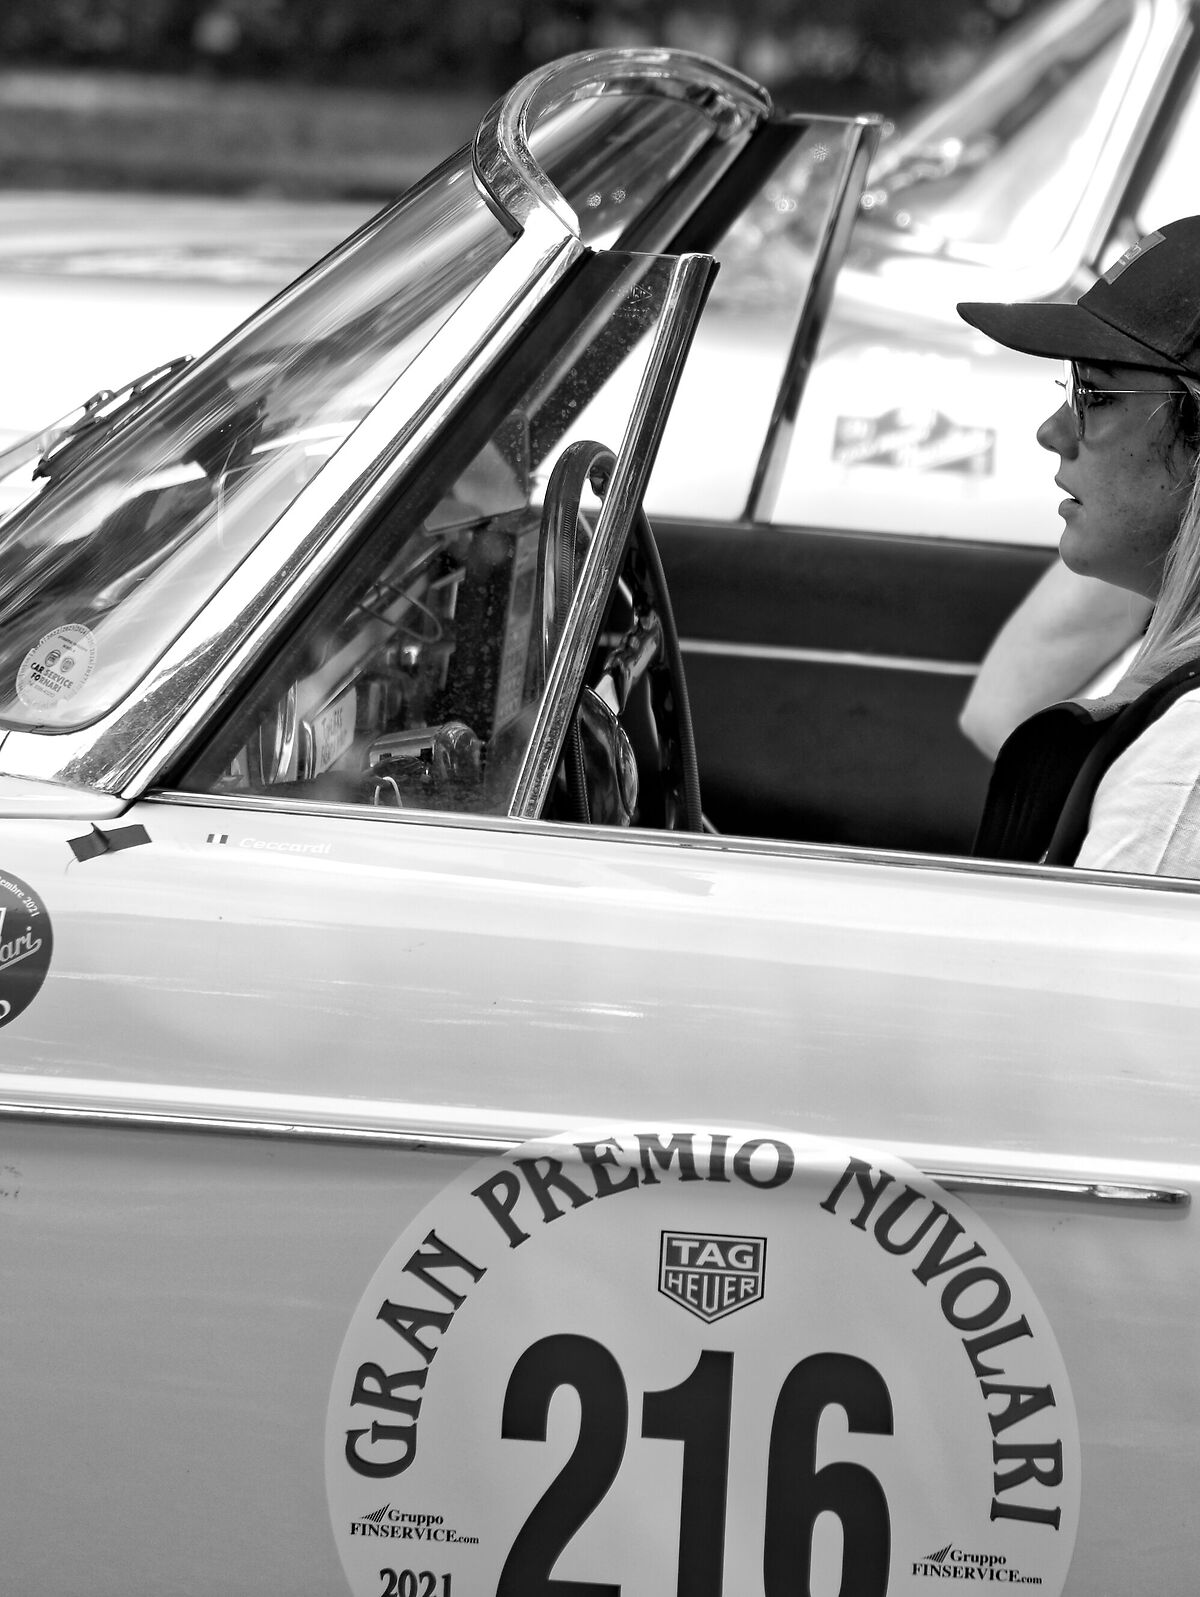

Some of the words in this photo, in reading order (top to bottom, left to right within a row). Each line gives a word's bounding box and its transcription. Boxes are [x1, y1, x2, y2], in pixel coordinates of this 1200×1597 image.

[30, 662, 45, 674] CAR
[44, 669, 74, 689] SERVICE
[30, 672, 62, 693] FORNARI
[22, 896, 40, 917] 2021
[671, 1239, 754, 1269] TAG
[667, 1272, 756, 1313] HEUER
[344, 1229, 488, 1480] GRAN
[471, 1132, 796, 1249] PREMIO
[819, 1155, 1064, 1532] NUVOLARI
[495, 1333, 895, 1597] 216
[387, 1509, 444, 1527] Gruppo
[350, 1522, 480, 1545] FINSERVICE.com
[949, 1549, 1007, 1567] Gruppo
[379, 1567, 453, 1597] 2021
[912, 1562, 1043, 1585] FINSERVICE.com
